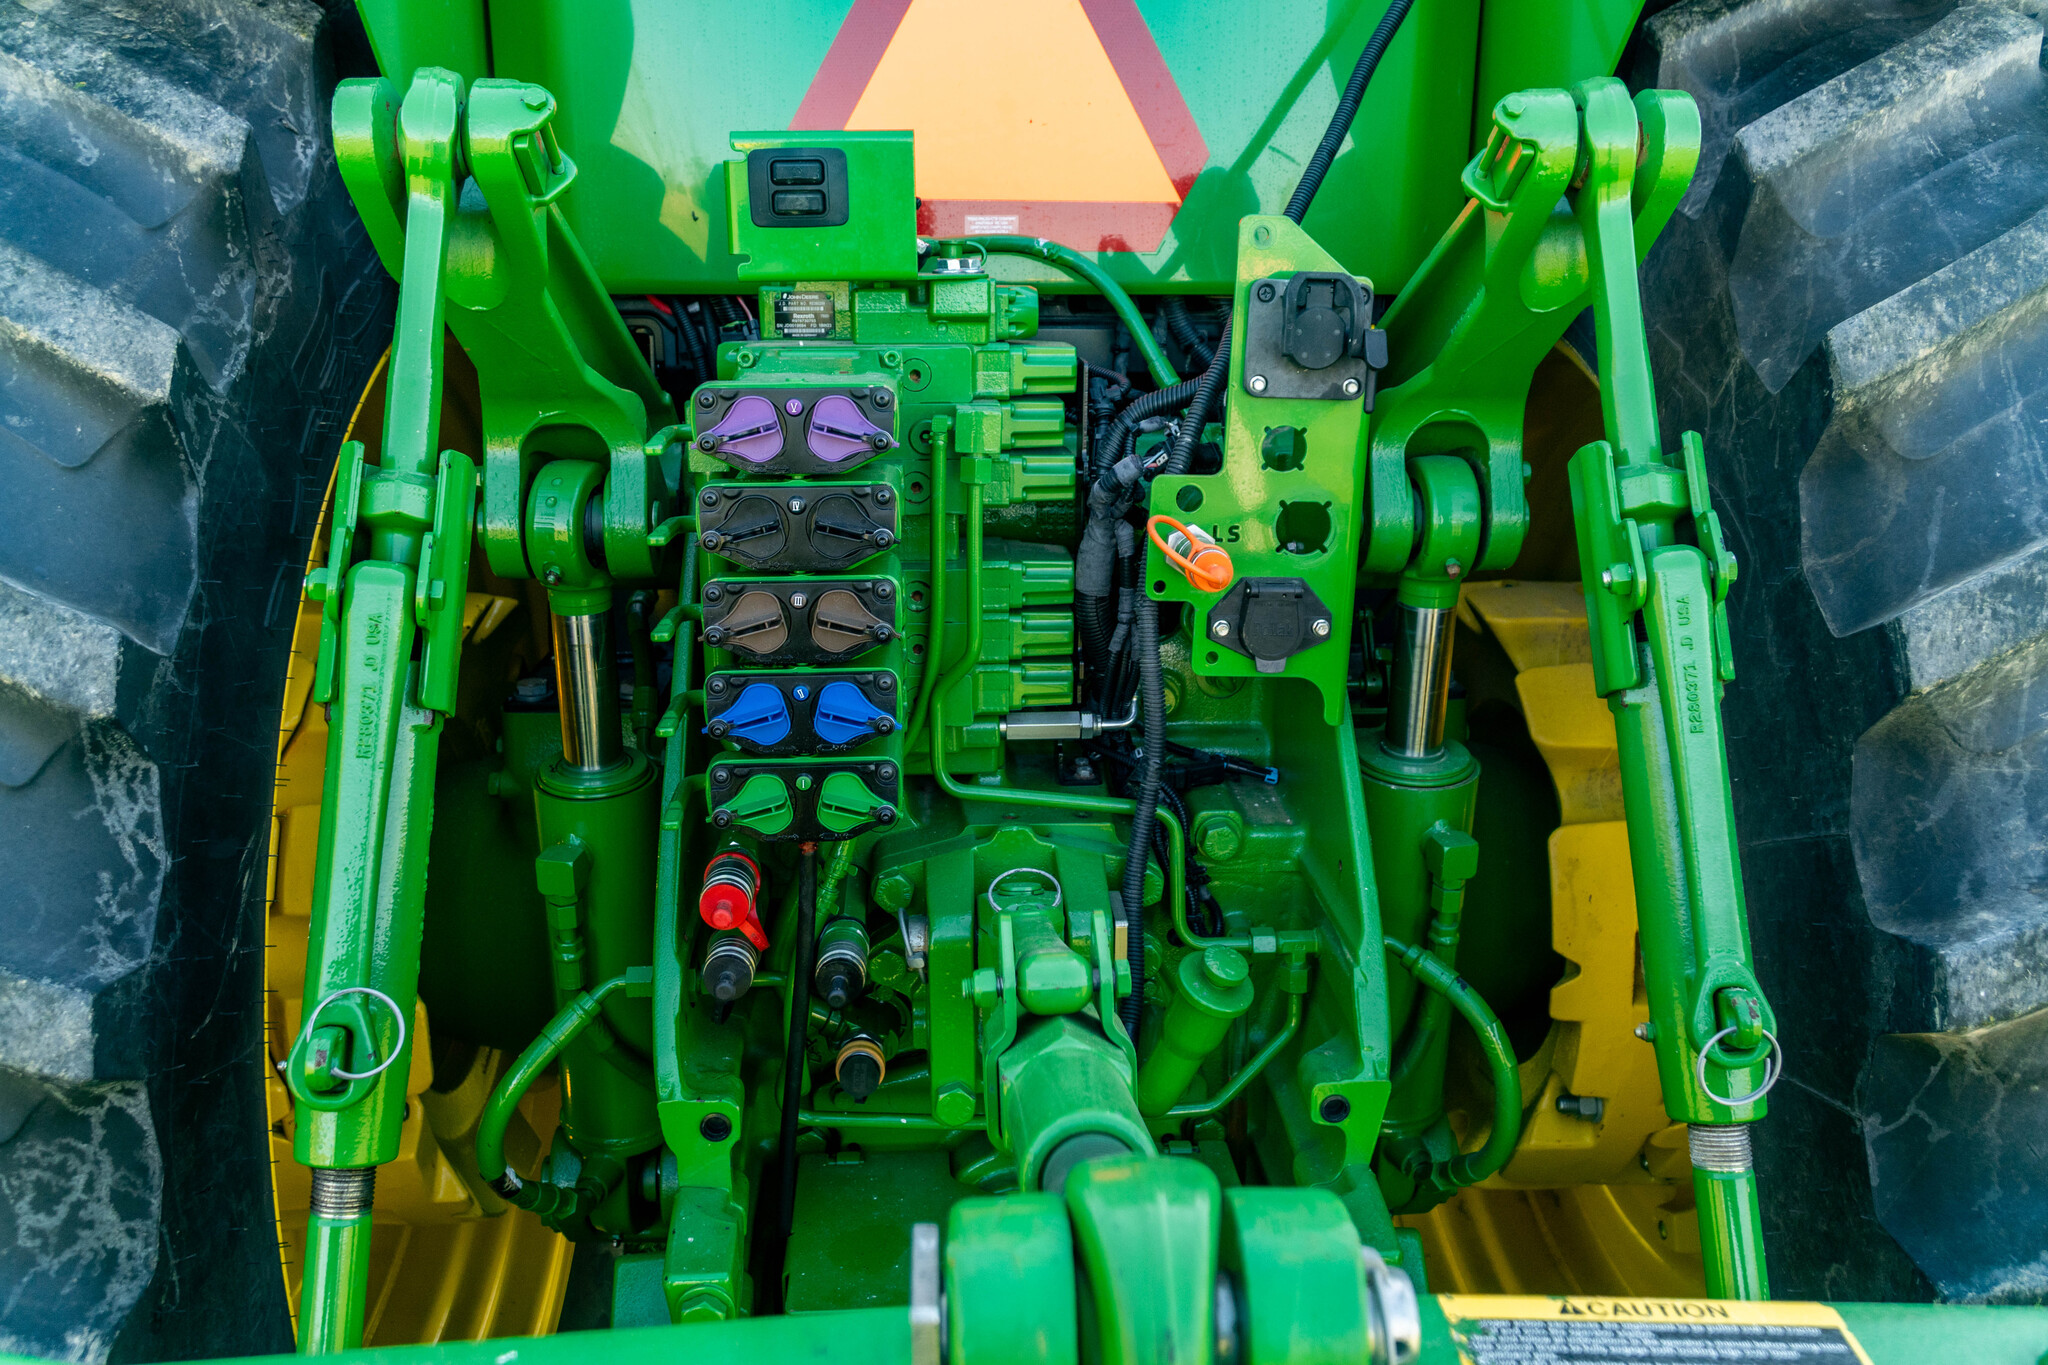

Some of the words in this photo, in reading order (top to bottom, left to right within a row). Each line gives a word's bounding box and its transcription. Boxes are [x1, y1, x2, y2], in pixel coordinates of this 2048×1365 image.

[790, 402, 798, 413] V
[1212, 525, 1240, 543] LS
[794, 596, 802, 605] III
[1677, 596, 1692, 626] USA
[1682, 663, 1704, 734] R280371
[1587, 1301, 1729, 1318] CAUTION
